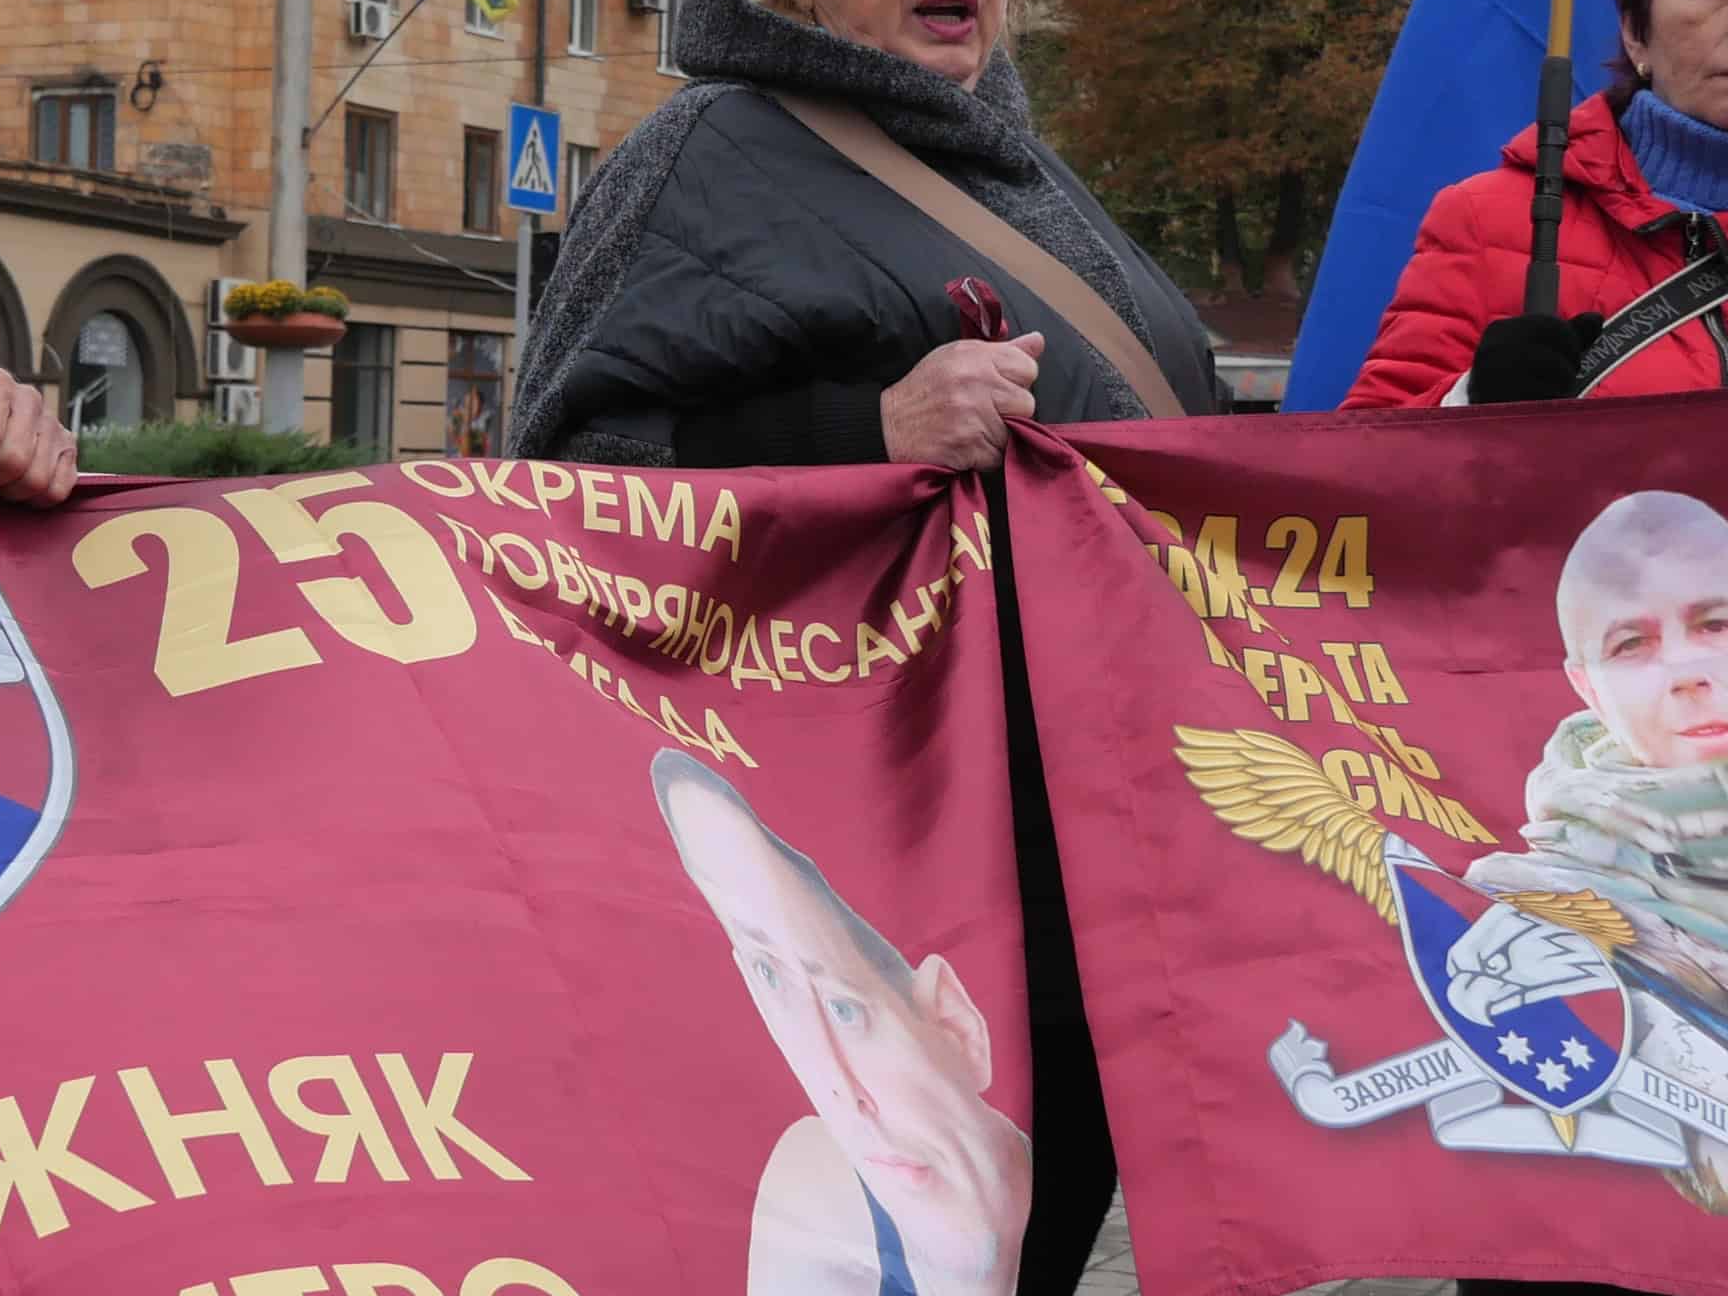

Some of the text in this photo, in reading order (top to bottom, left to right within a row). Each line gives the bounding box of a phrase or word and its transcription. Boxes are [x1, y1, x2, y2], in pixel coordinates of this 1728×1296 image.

[400, 459, 742, 563] ОКРЕМА
[72, 470, 477, 697] 25
[1334, 1046, 1462, 1114] ЗАВЖДИ
